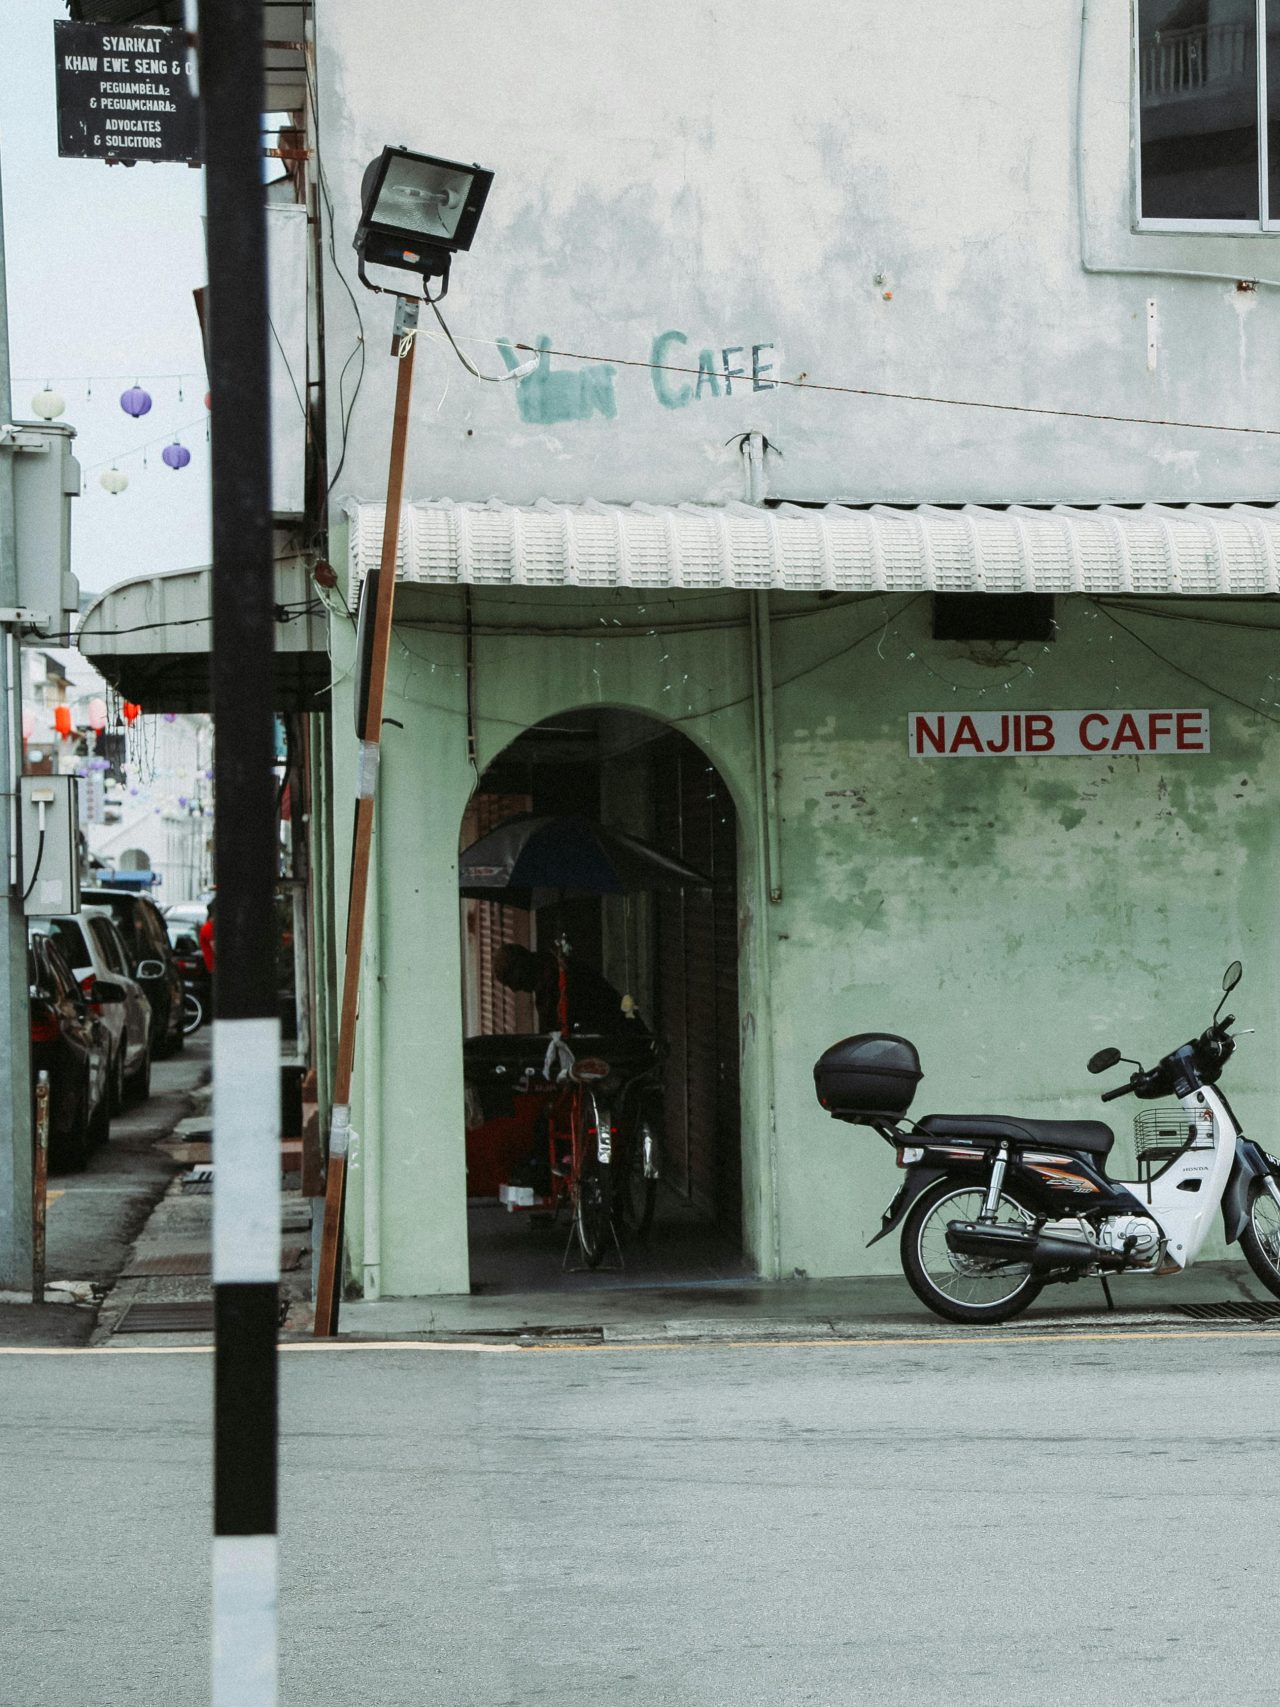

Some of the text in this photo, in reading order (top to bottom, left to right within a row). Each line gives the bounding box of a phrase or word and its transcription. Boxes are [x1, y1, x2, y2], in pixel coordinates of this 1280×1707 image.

[103, 36, 161, 53] SYARIKAT
[64, 55, 98, 71] KHAW
[103, 57, 130, 73] EWE
[135, 59, 168, 74] SENG
[172, 61, 181, 75] &
[90, 97, 97, 109] &
[105, 119, 161, 132] ADVOCATES
[94, 134, 162, 148] & SOLICITORS
[915, 713, 1204, 754] NAJIB CAFE
